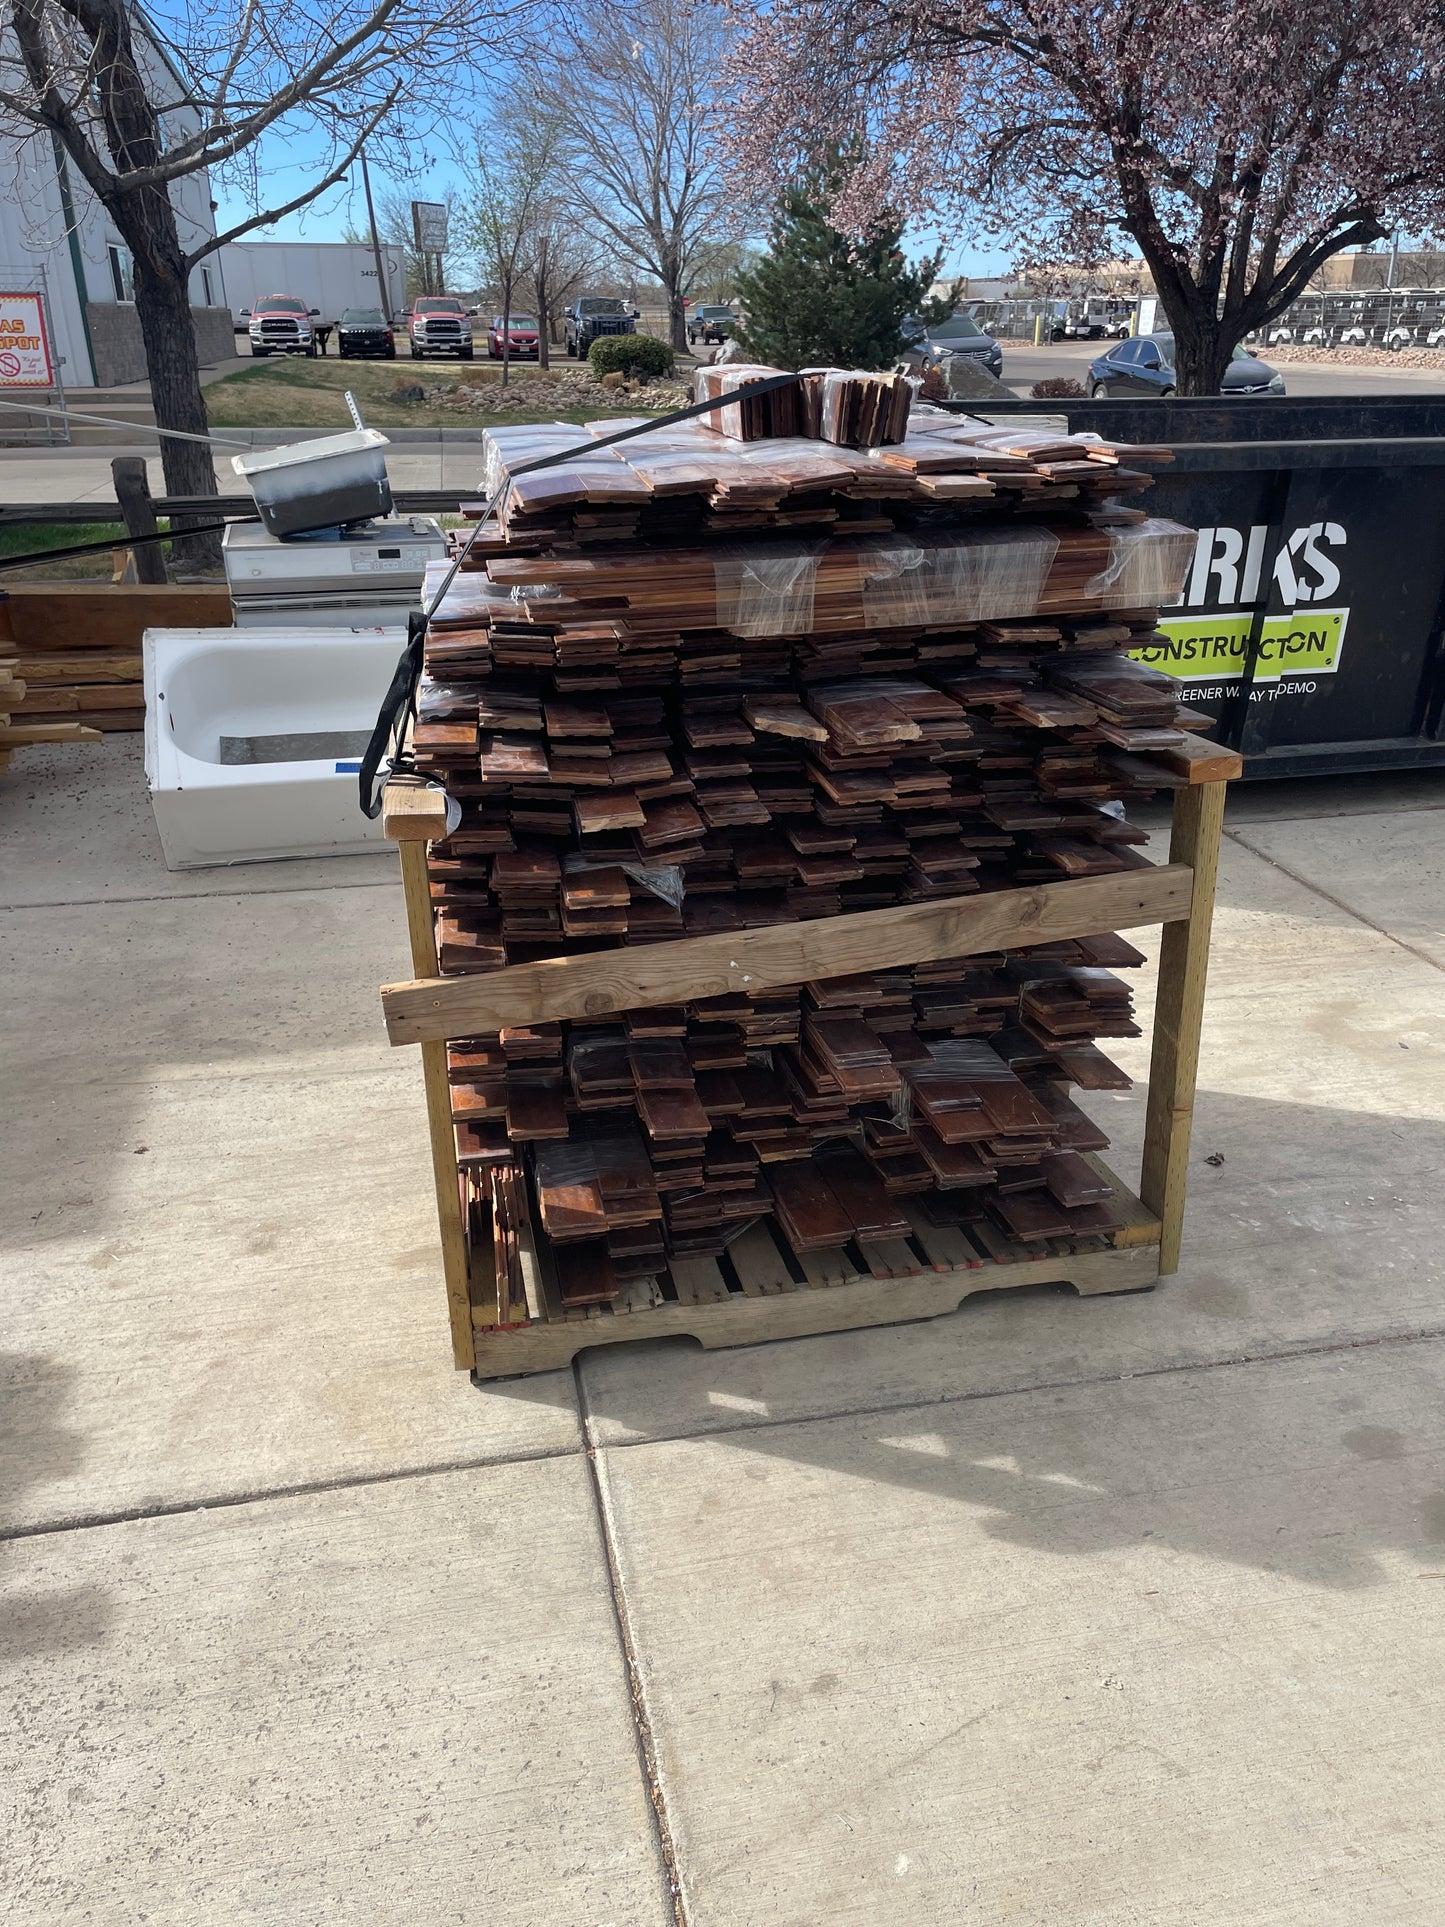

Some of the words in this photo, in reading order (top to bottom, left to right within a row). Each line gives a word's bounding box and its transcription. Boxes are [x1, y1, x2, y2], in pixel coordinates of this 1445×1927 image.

[1162, 522, 1347, 607] RIKS
[1174, 687, 1223, 703] REENER
[1276, 681, 1317, 695] DEMO
